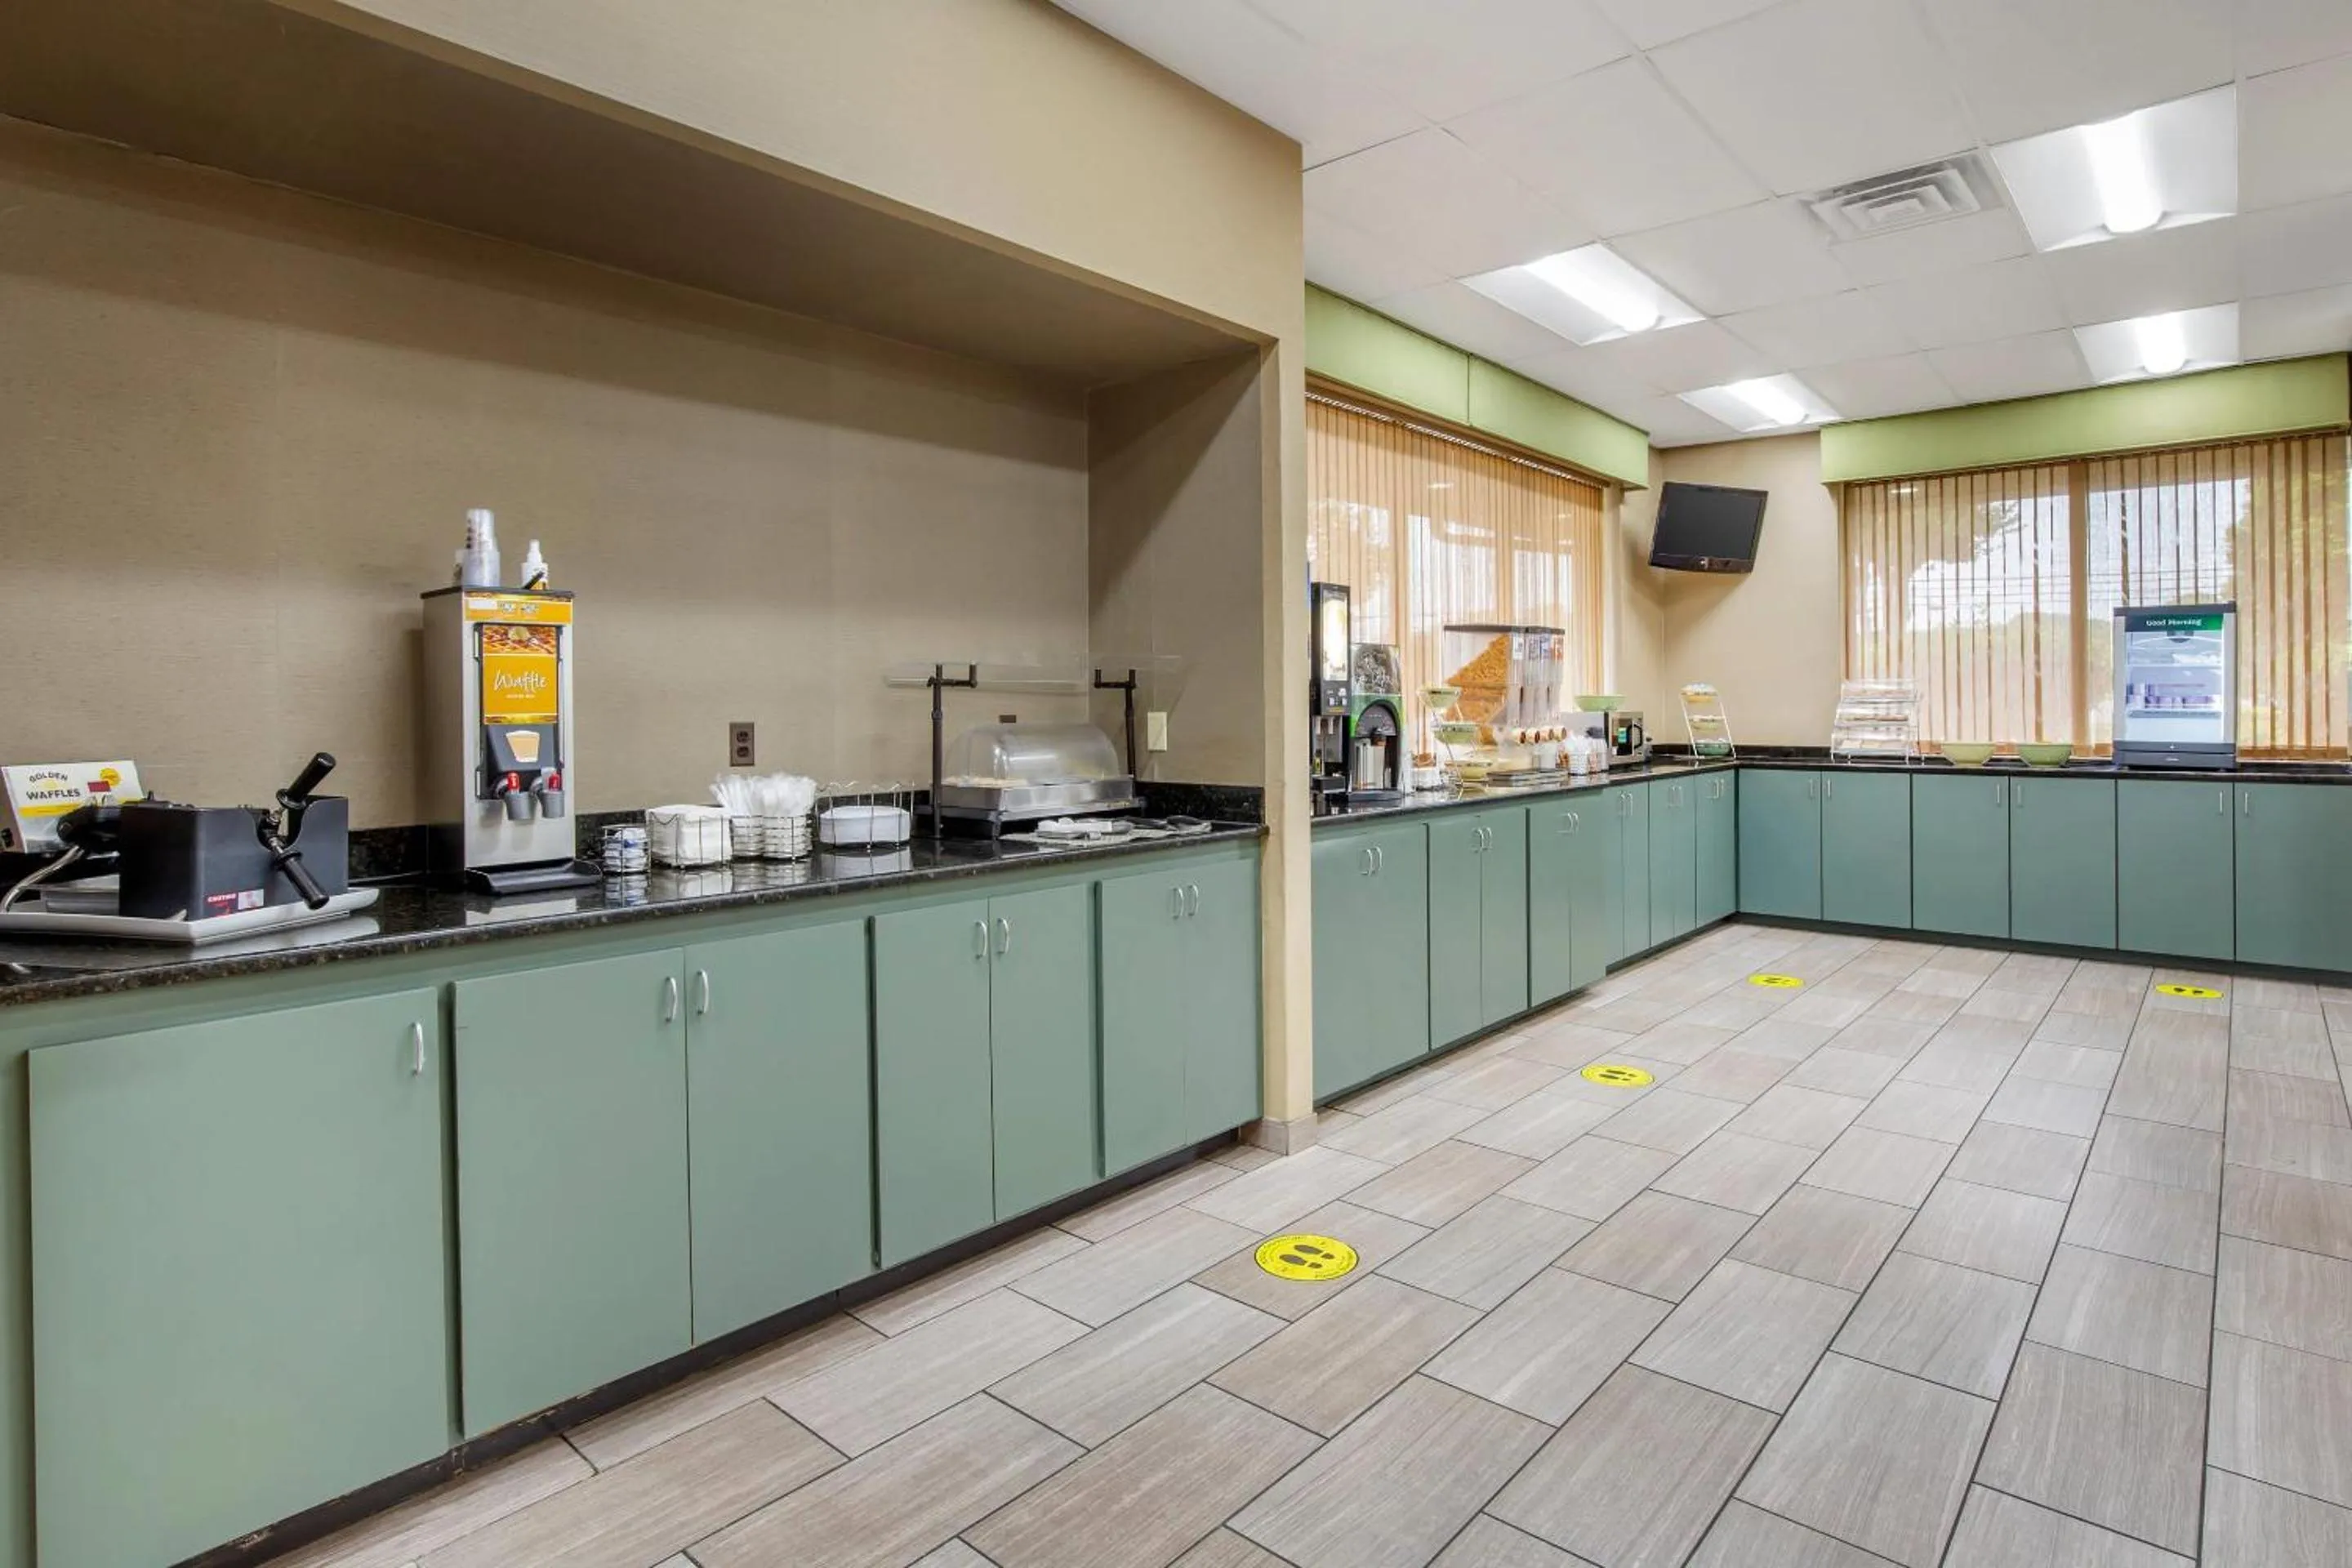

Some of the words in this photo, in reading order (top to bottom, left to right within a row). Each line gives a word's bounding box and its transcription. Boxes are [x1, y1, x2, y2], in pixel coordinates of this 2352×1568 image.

[493, 669, 547, 693] Waffle
[29, 772, 69, 783] GOLDEN
[26, 788, 81, 800] WAFFLES
